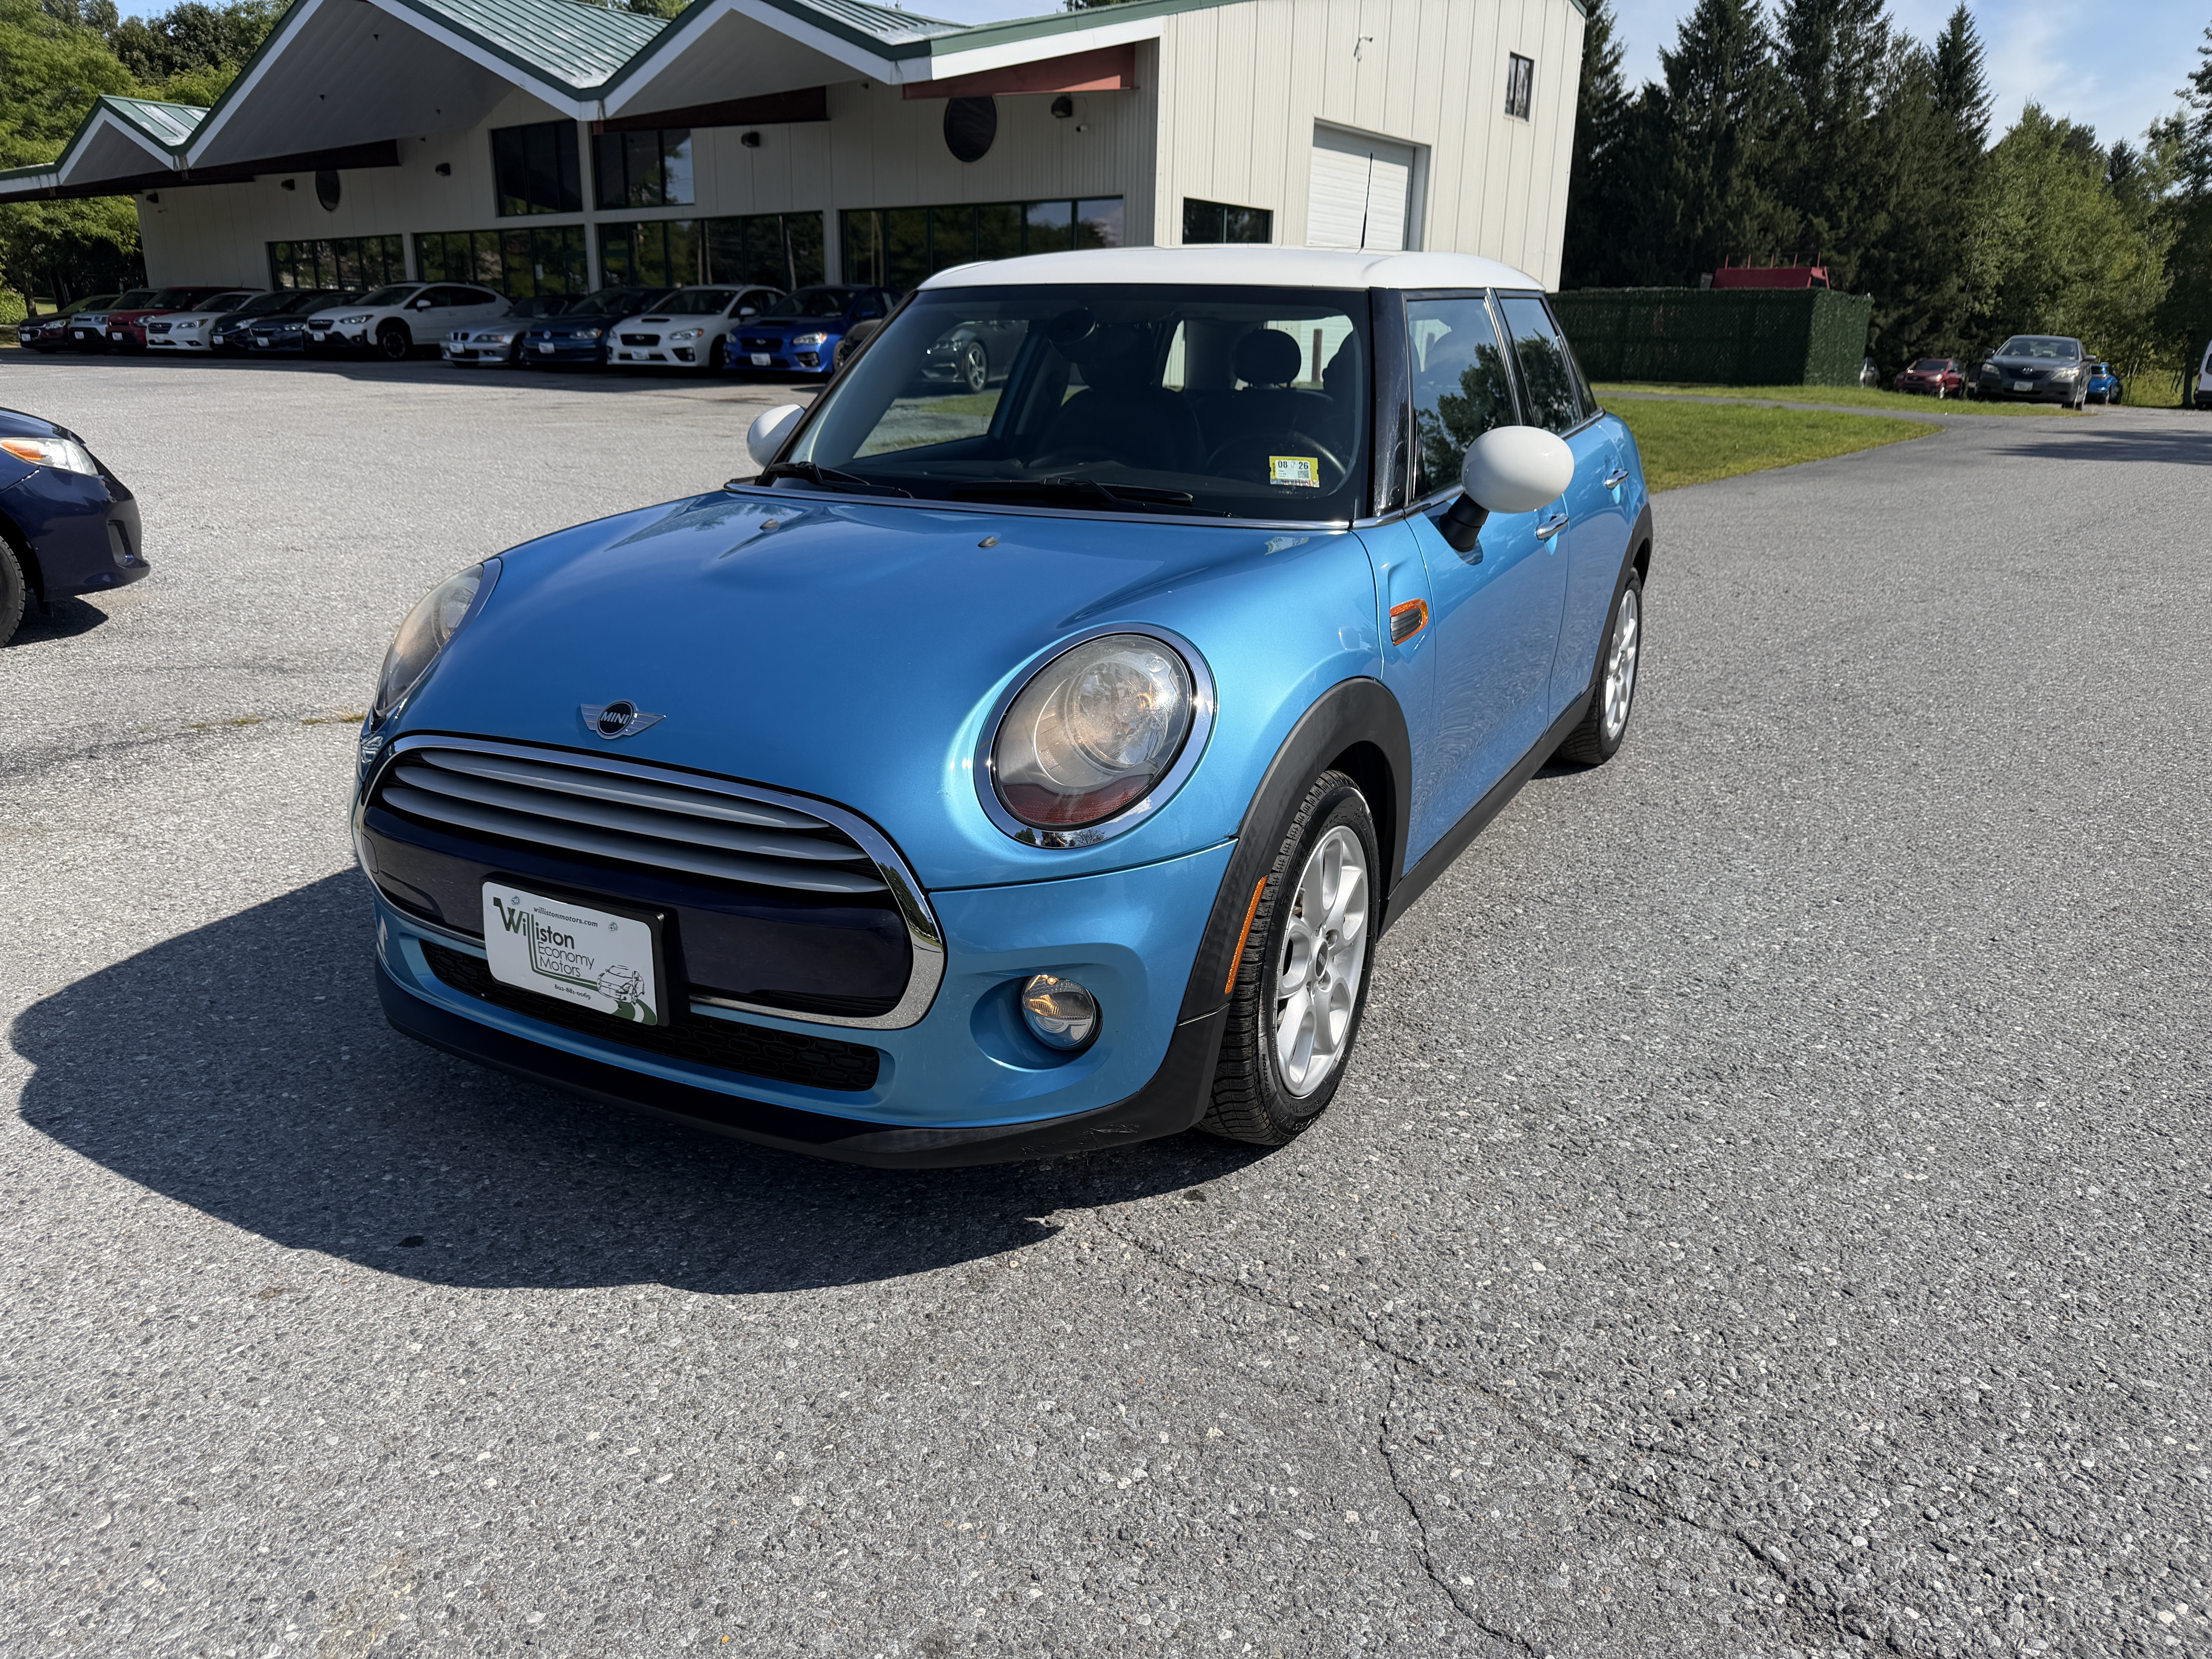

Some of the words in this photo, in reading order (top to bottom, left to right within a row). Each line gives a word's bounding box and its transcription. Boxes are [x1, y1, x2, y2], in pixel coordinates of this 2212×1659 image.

[601, 711, 630, 725] MINI
[493, 896, 575, 949] Williston
[534, 907, 598, 927] willistonmotors.com
[538, 941, 594, 970] Economy
[540, 955, 581, 977] Motors
[1262, 1054, 1271, 1098] ROTATION
